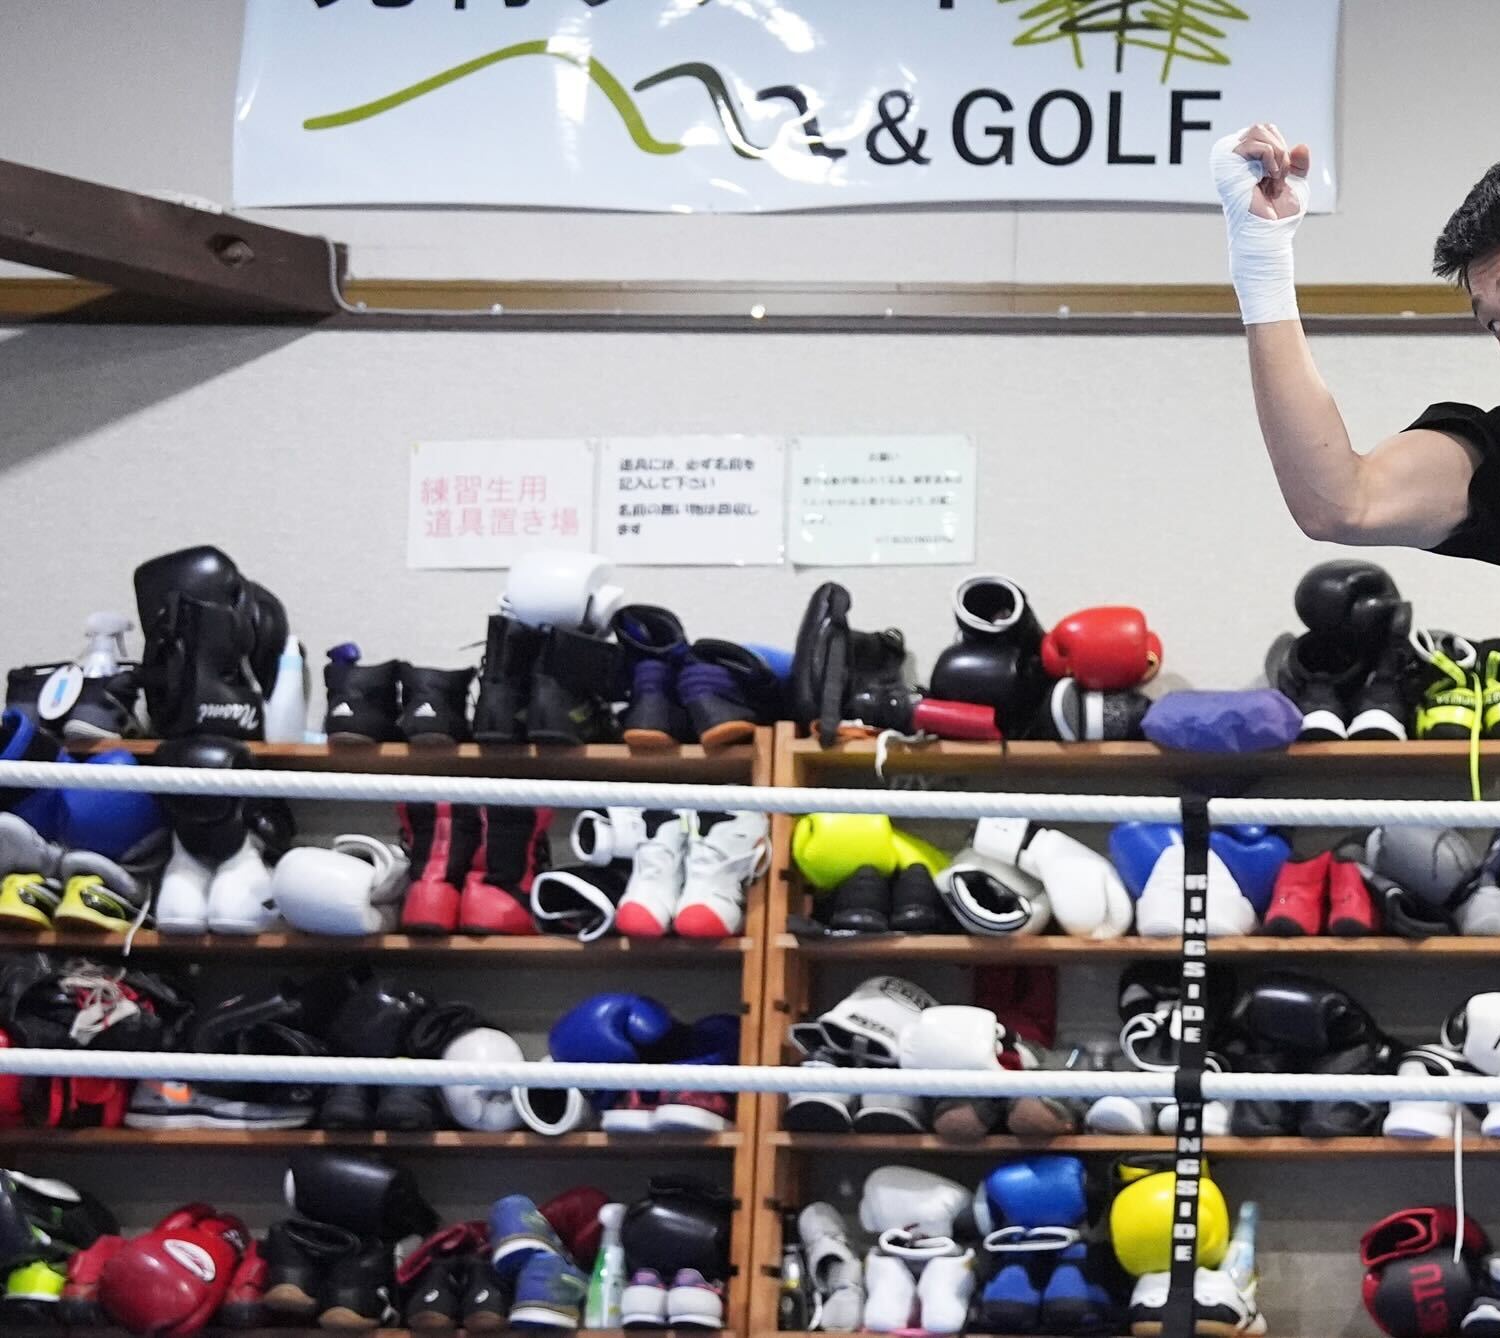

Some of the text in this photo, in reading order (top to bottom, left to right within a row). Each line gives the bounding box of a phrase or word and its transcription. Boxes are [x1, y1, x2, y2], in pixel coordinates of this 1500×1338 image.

[866, 88, 1221, 166] & GOLF
[420, 475, 546, 505] 練習生用
[425, 507, 579, 538] 道具置き場
[1174, 1108, 1201, 1261] INGSIDE
